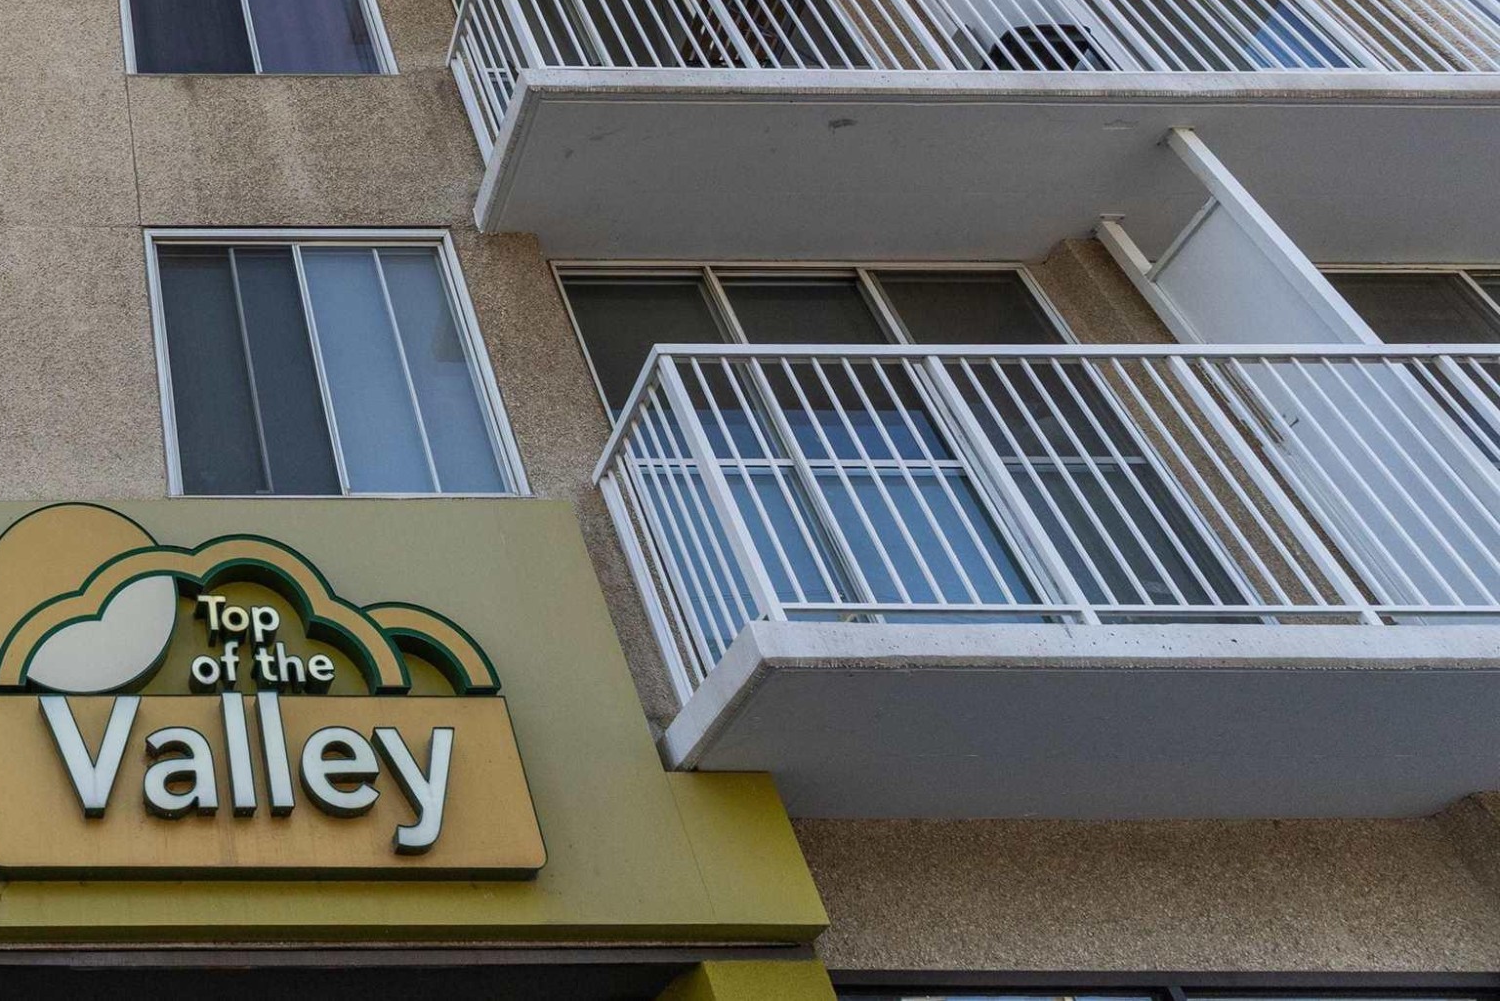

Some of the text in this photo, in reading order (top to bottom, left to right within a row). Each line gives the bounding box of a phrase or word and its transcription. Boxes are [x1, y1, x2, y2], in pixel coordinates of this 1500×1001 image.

[197, 595, 280, 643] Top
[191, 641, 335, 685] of the
[38, 691, 456, 853] Valley
